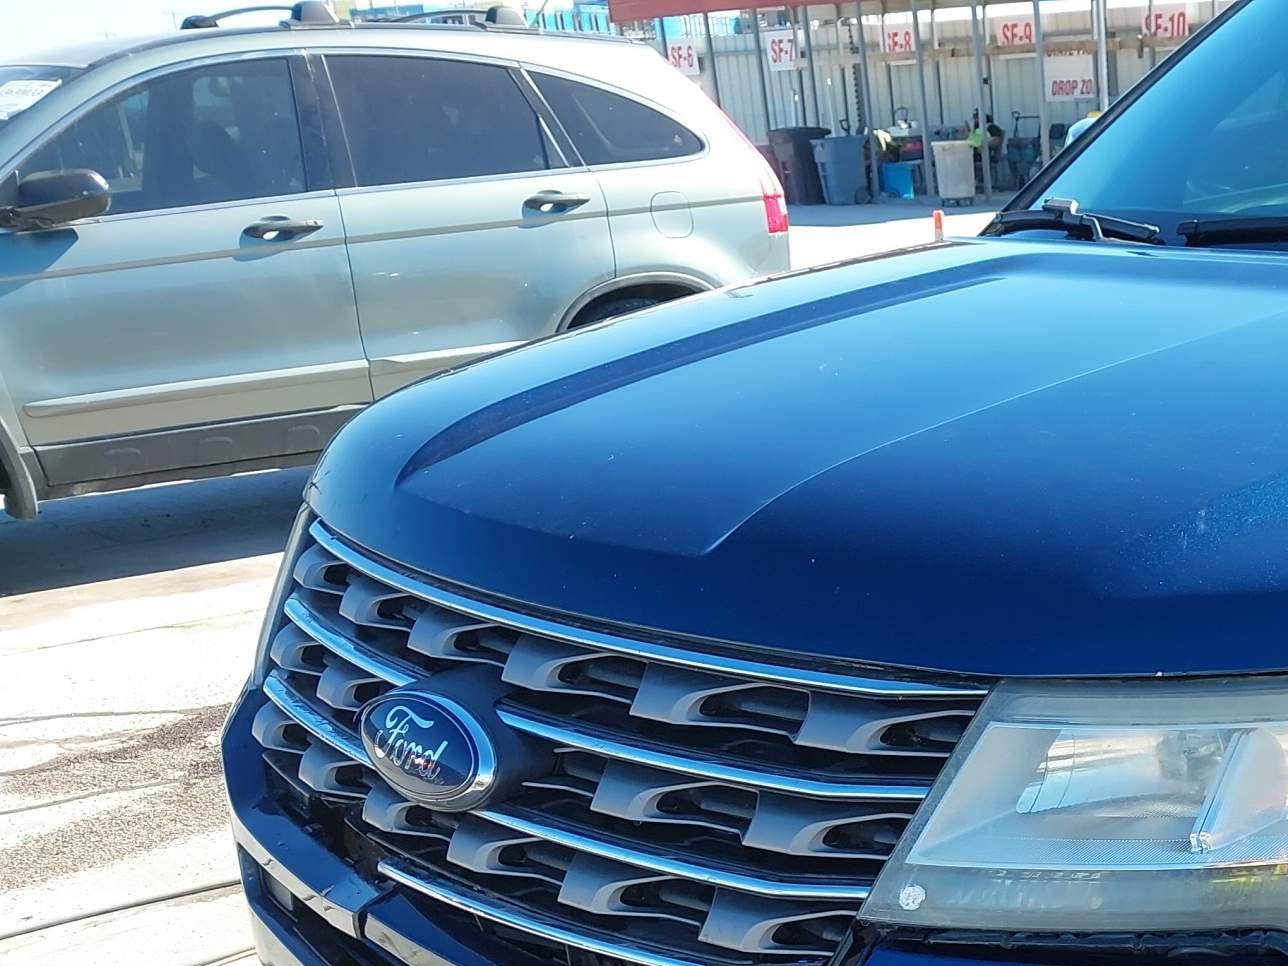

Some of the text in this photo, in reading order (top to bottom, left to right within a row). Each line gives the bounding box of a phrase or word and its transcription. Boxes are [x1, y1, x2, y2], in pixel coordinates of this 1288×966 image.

[1001, 22, 1033, 46] SF-9
[670, 45, 694, 68] SF-6
[770, 38, 796, 64] SF-7
[1051, 79, 1079, 96] DROP
[374, 705, 449, 780] Ford
